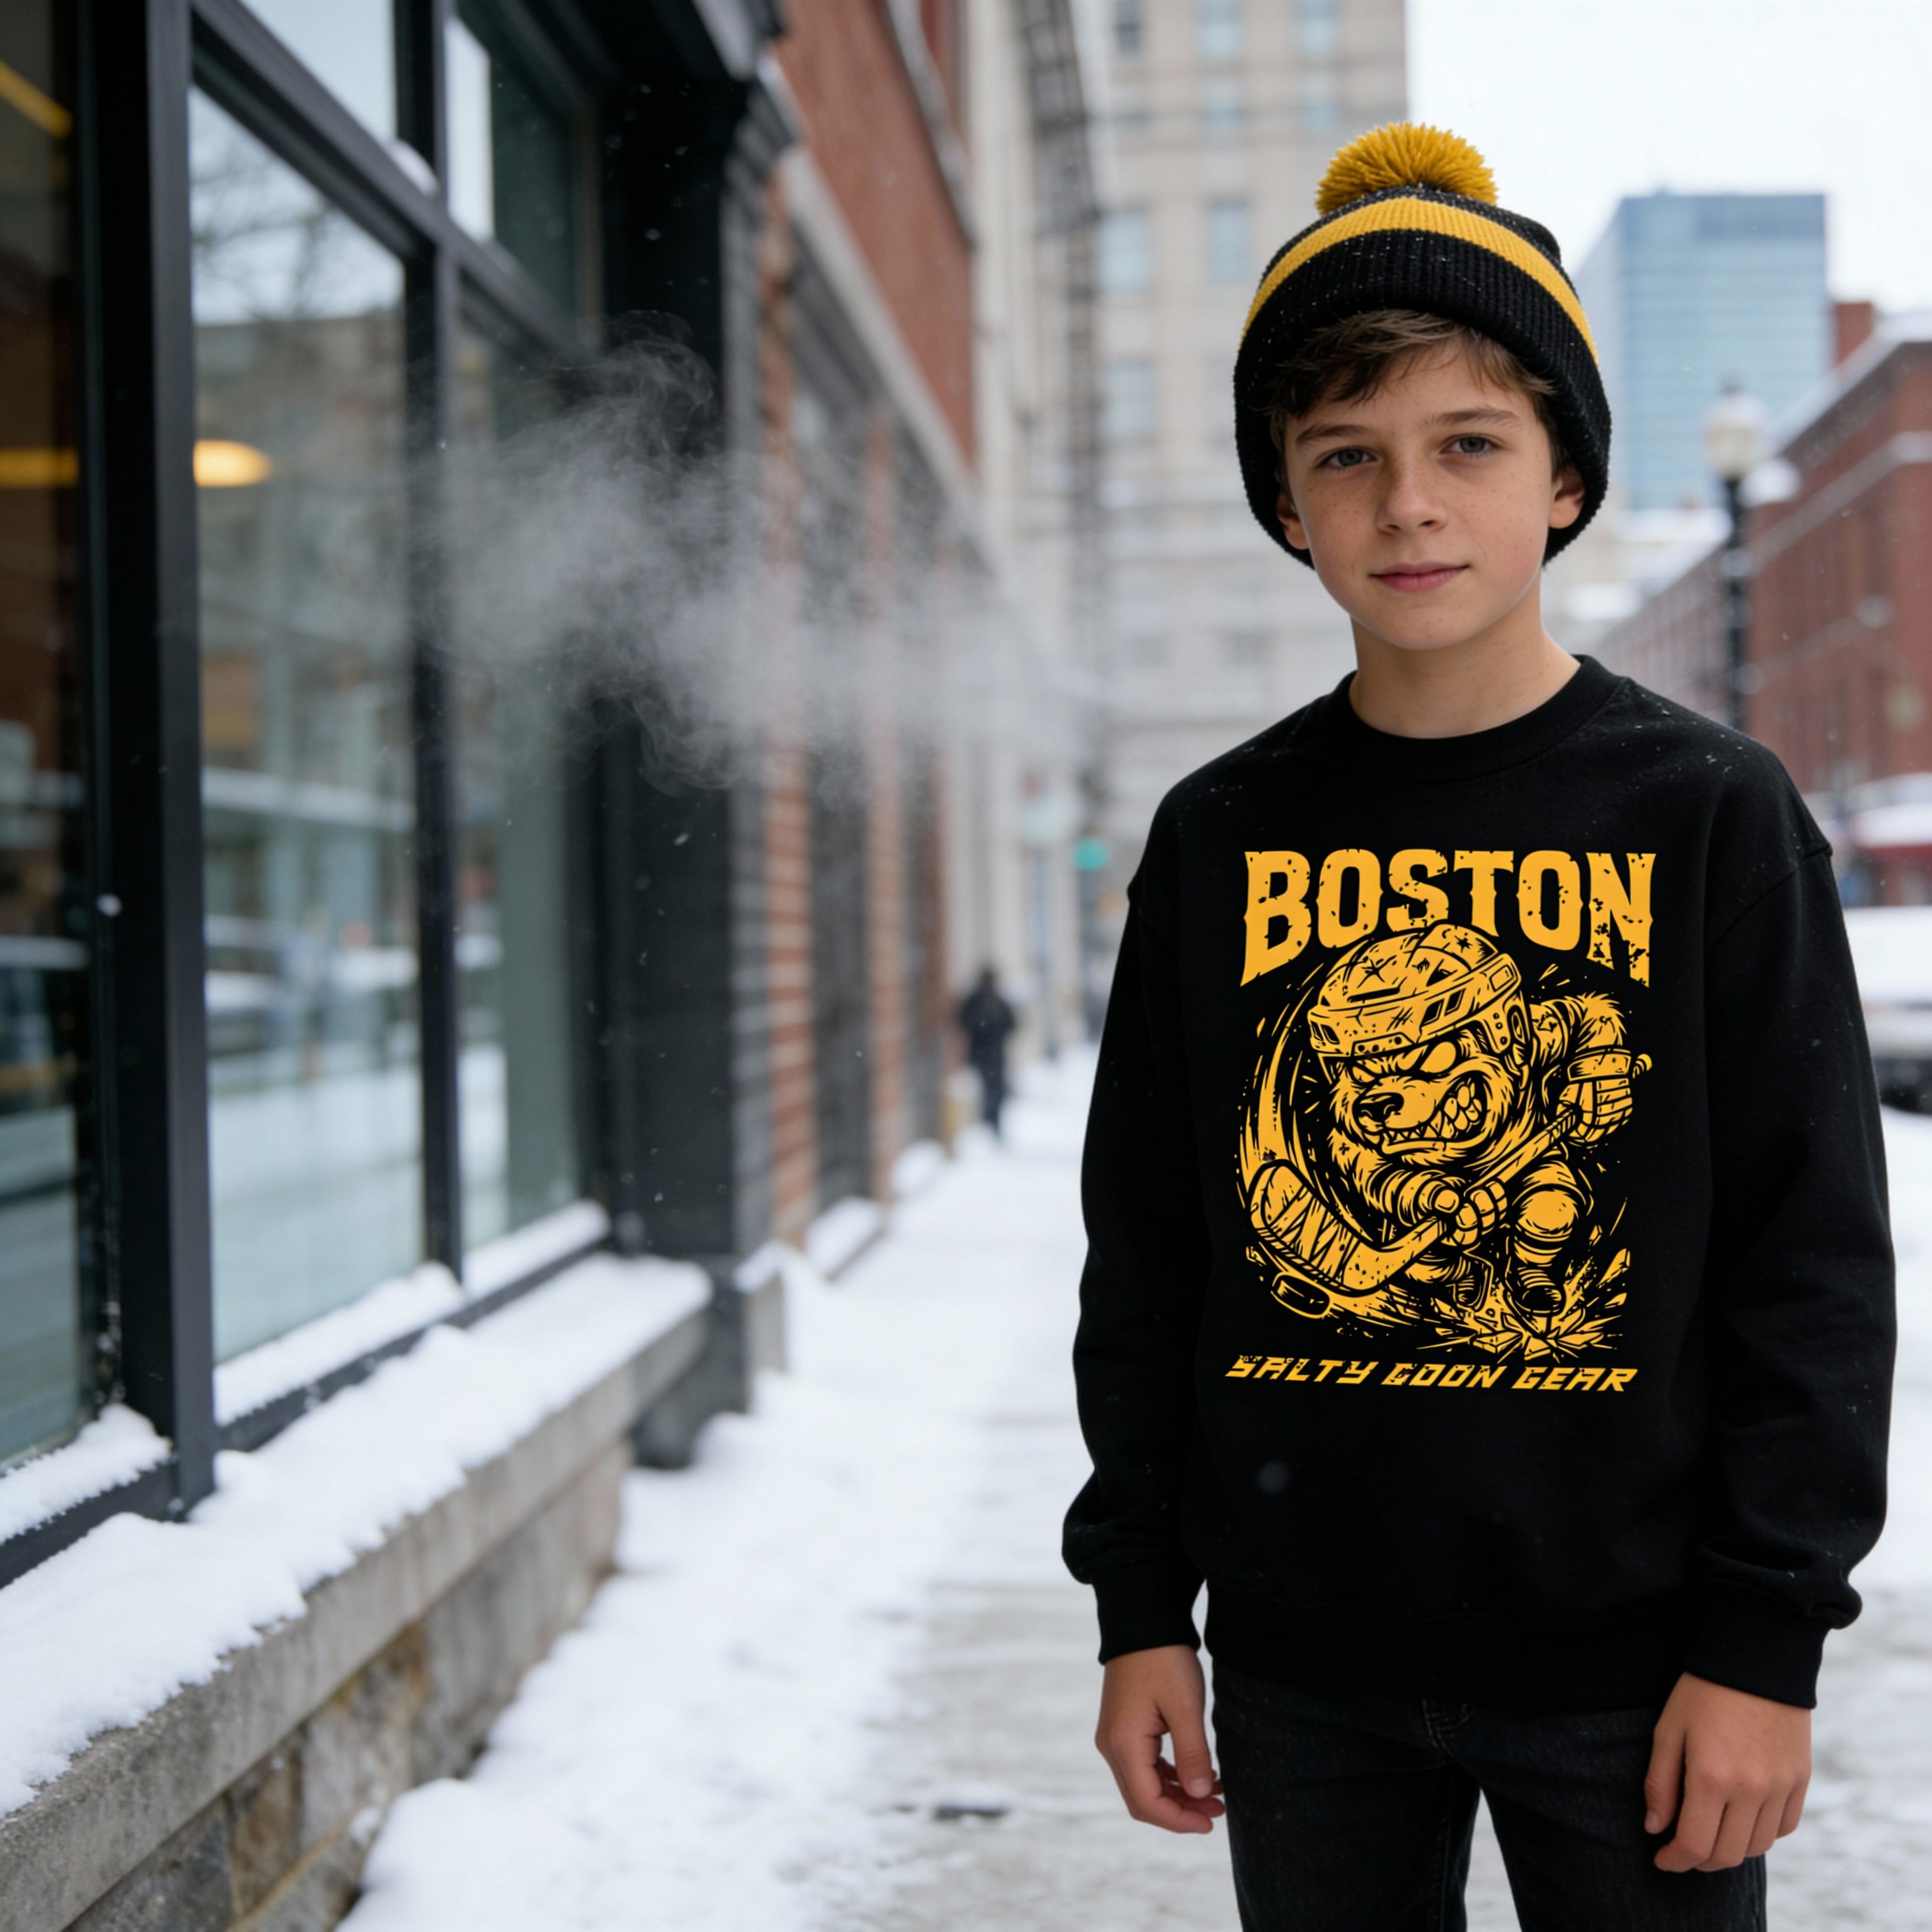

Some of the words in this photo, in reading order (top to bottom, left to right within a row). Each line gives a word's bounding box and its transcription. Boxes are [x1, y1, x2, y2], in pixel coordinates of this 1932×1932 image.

[1240, 849, 1656, 988] BOSTON
[1225, 1355, 1379, 1384] SALTY
[1381, 1363, 1507, 1388] GOON
[1511, 1366, 1638, 1392] GEAR
